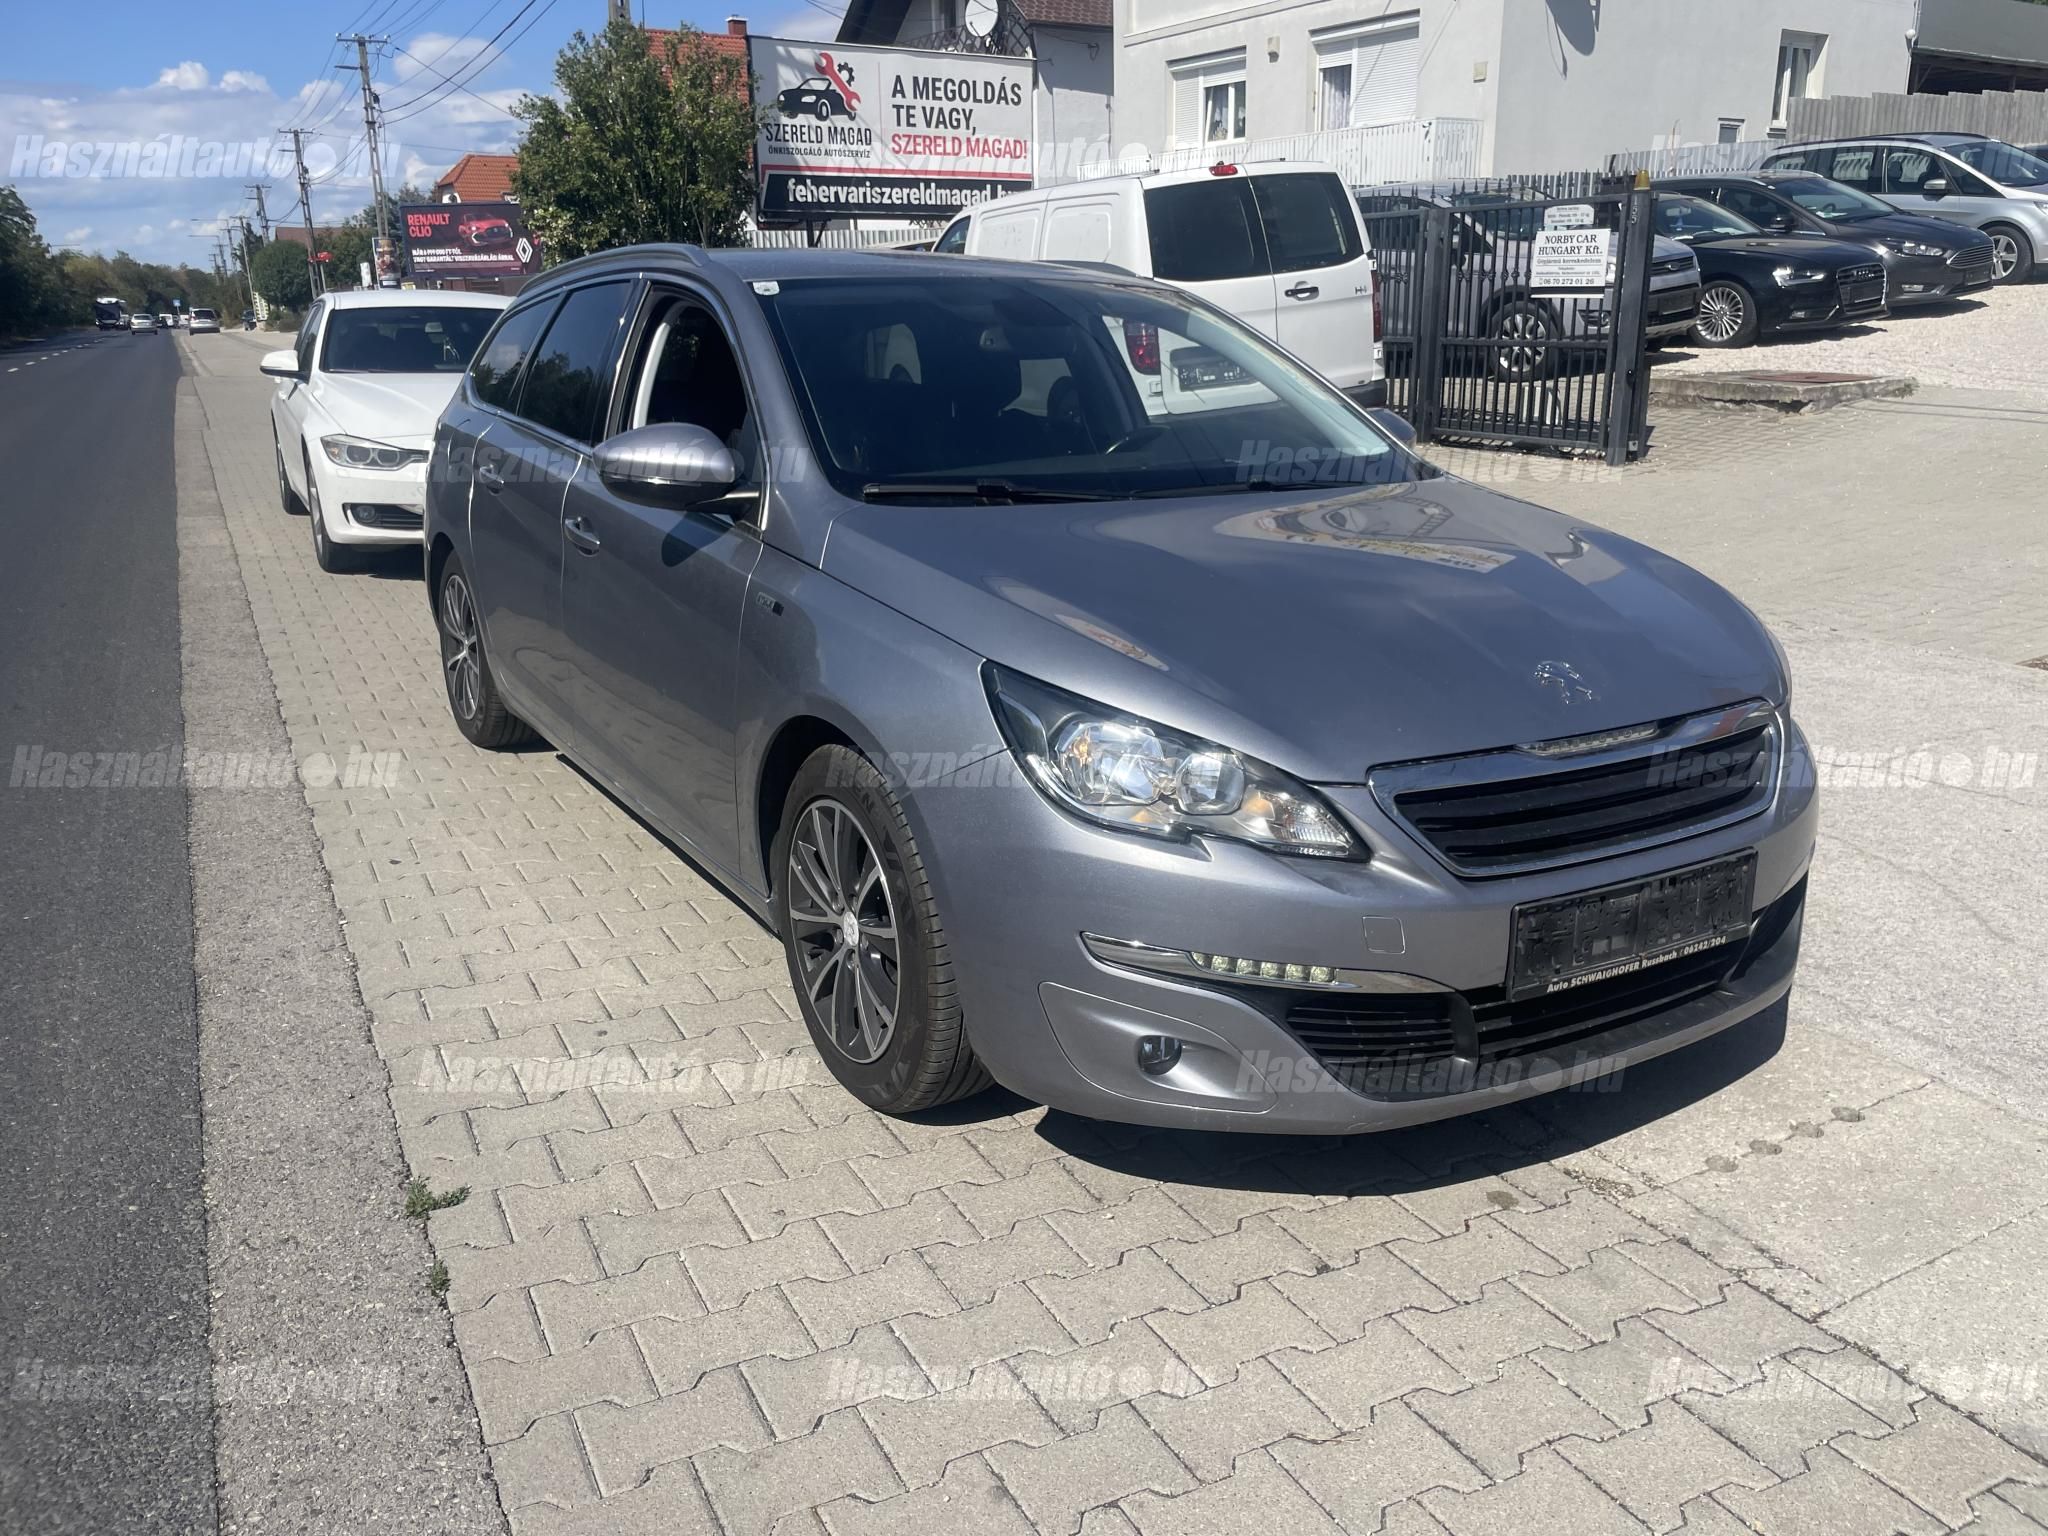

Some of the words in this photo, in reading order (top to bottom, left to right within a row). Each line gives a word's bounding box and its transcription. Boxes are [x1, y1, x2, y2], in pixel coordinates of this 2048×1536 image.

[892, 75, 905, 98] A
[913, 74, 1022, 106] MEGOLDÁS
[892, 105, 916, 128] TE
[921, 106, 977, 135] VAGY,
[765, 122, 823, 144] SZERELD
[828, 126, 872, 146] MAGAD
[768, 145, 822, 156] ÖNKISZOLGÁLÓ
[824, 148, 871, 158] AUTÓSZERVÍZ
[891, 133, 962, 157] SZERELD
[966, 136, 1028, 160] MAGAD!
[787, 178, 1017, 206] fehervariszereldmagadh
[407, 213, 450, 226] RENAULT
[409, 226, 432, 238] CLIO
[1544, 234, 1575, 245] NORBY
[1576, 234, 1597, 243] CAR
[1538, 246, 1583, 256] HUNGARY
[1585, 245, 1603, 255] Kft.
[1547, 982, 1568, 993] Auto
[1570, 961, 1640, 987] SCHWAIGHOFER
[1641, 950, 1677, 968] Russbach
